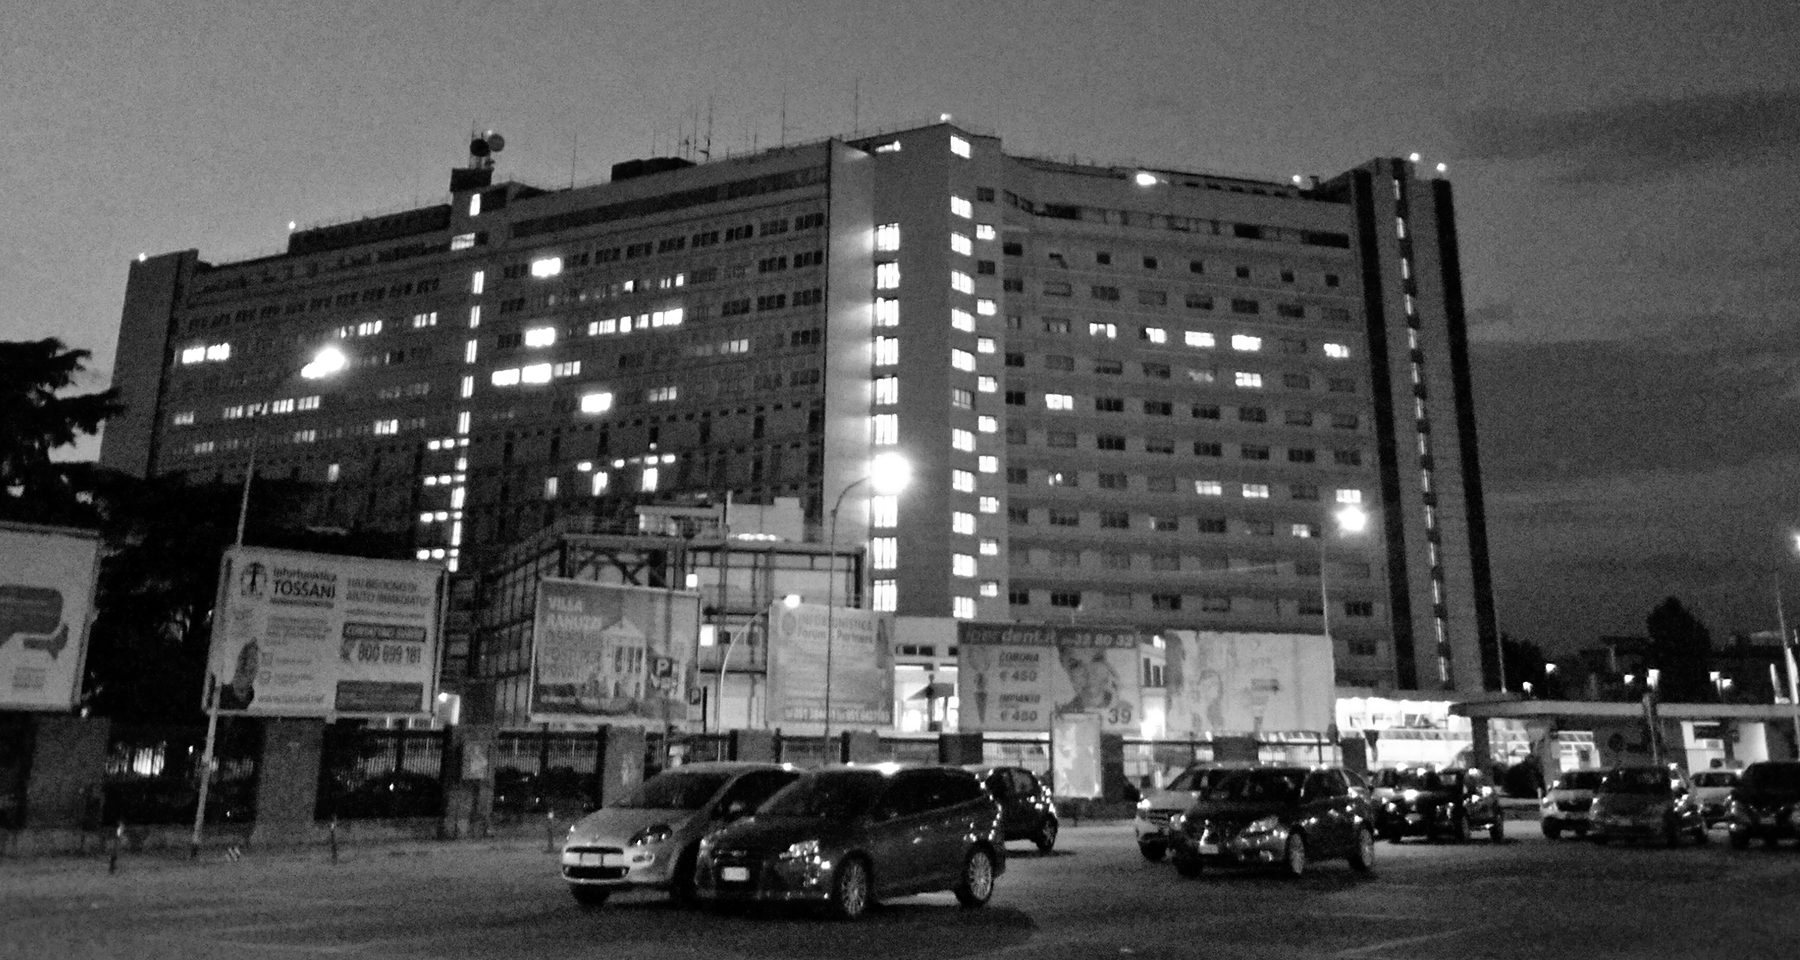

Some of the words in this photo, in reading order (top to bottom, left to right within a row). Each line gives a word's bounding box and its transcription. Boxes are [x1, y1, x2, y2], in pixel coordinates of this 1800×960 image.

[273, 580, 336, 599] TOSSANI
[548, 596, 583, 613] VILLA
[1107, 708, 1132, 724] 39
